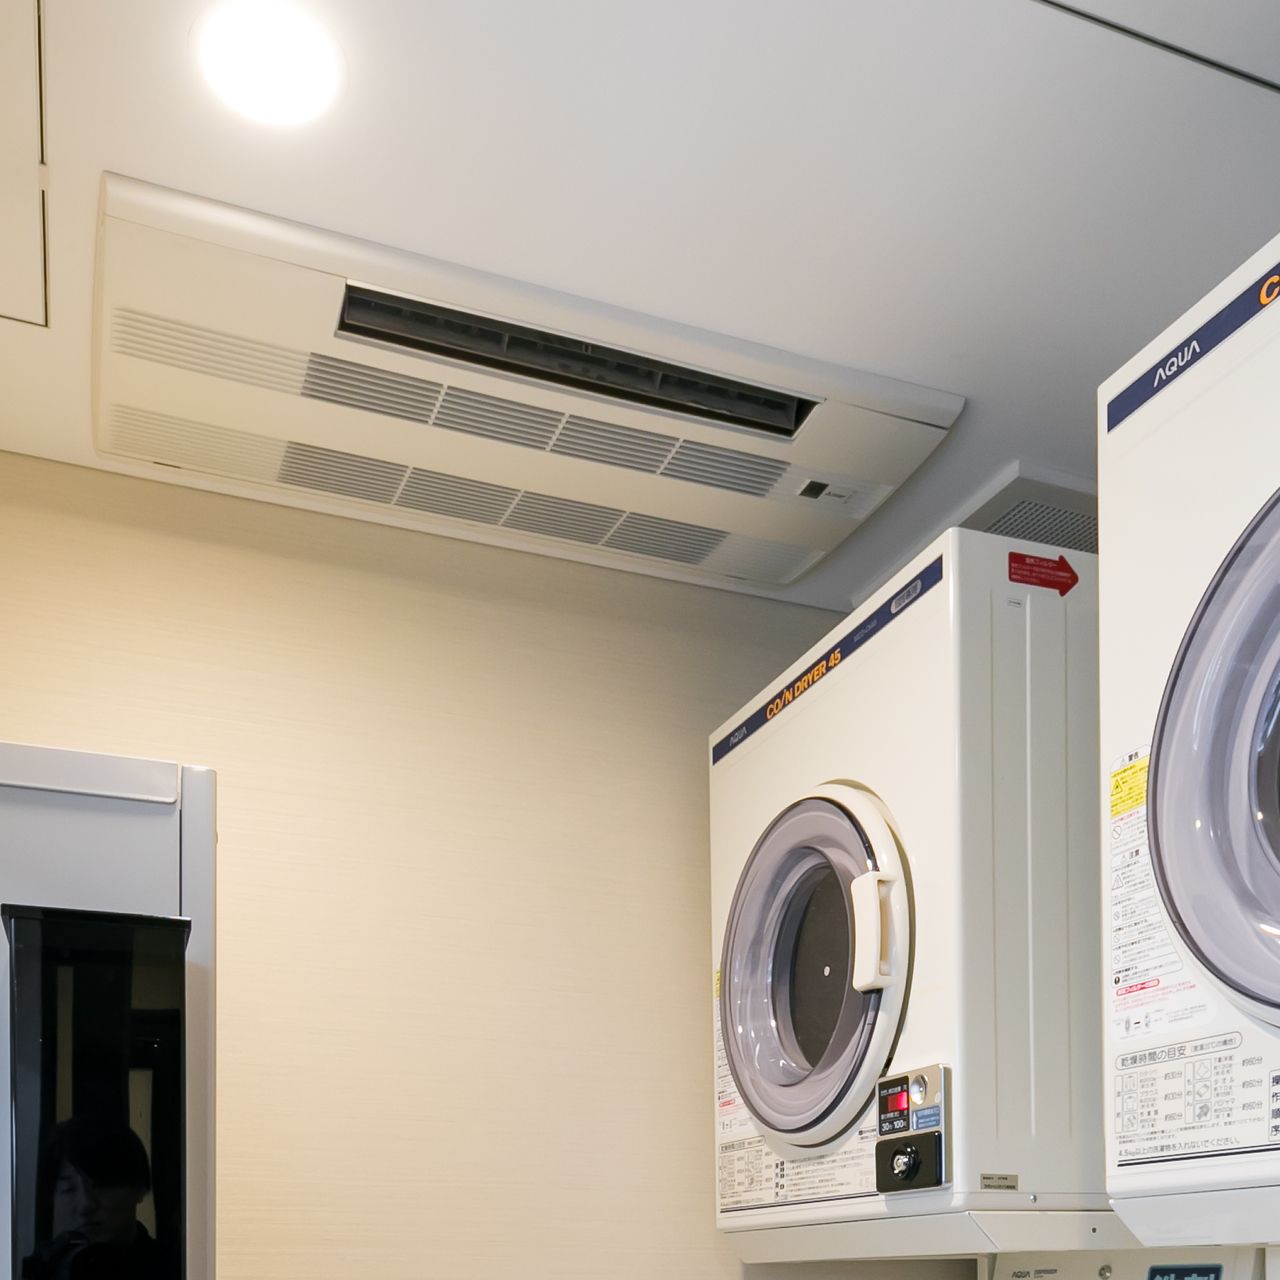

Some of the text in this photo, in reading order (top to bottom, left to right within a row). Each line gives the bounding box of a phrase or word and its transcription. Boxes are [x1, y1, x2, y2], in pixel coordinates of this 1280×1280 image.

[1153, 339, 1201, 387] AQUA
[794, 660, 826, 698] DRYER
[828, 648, 842, 667] 45
